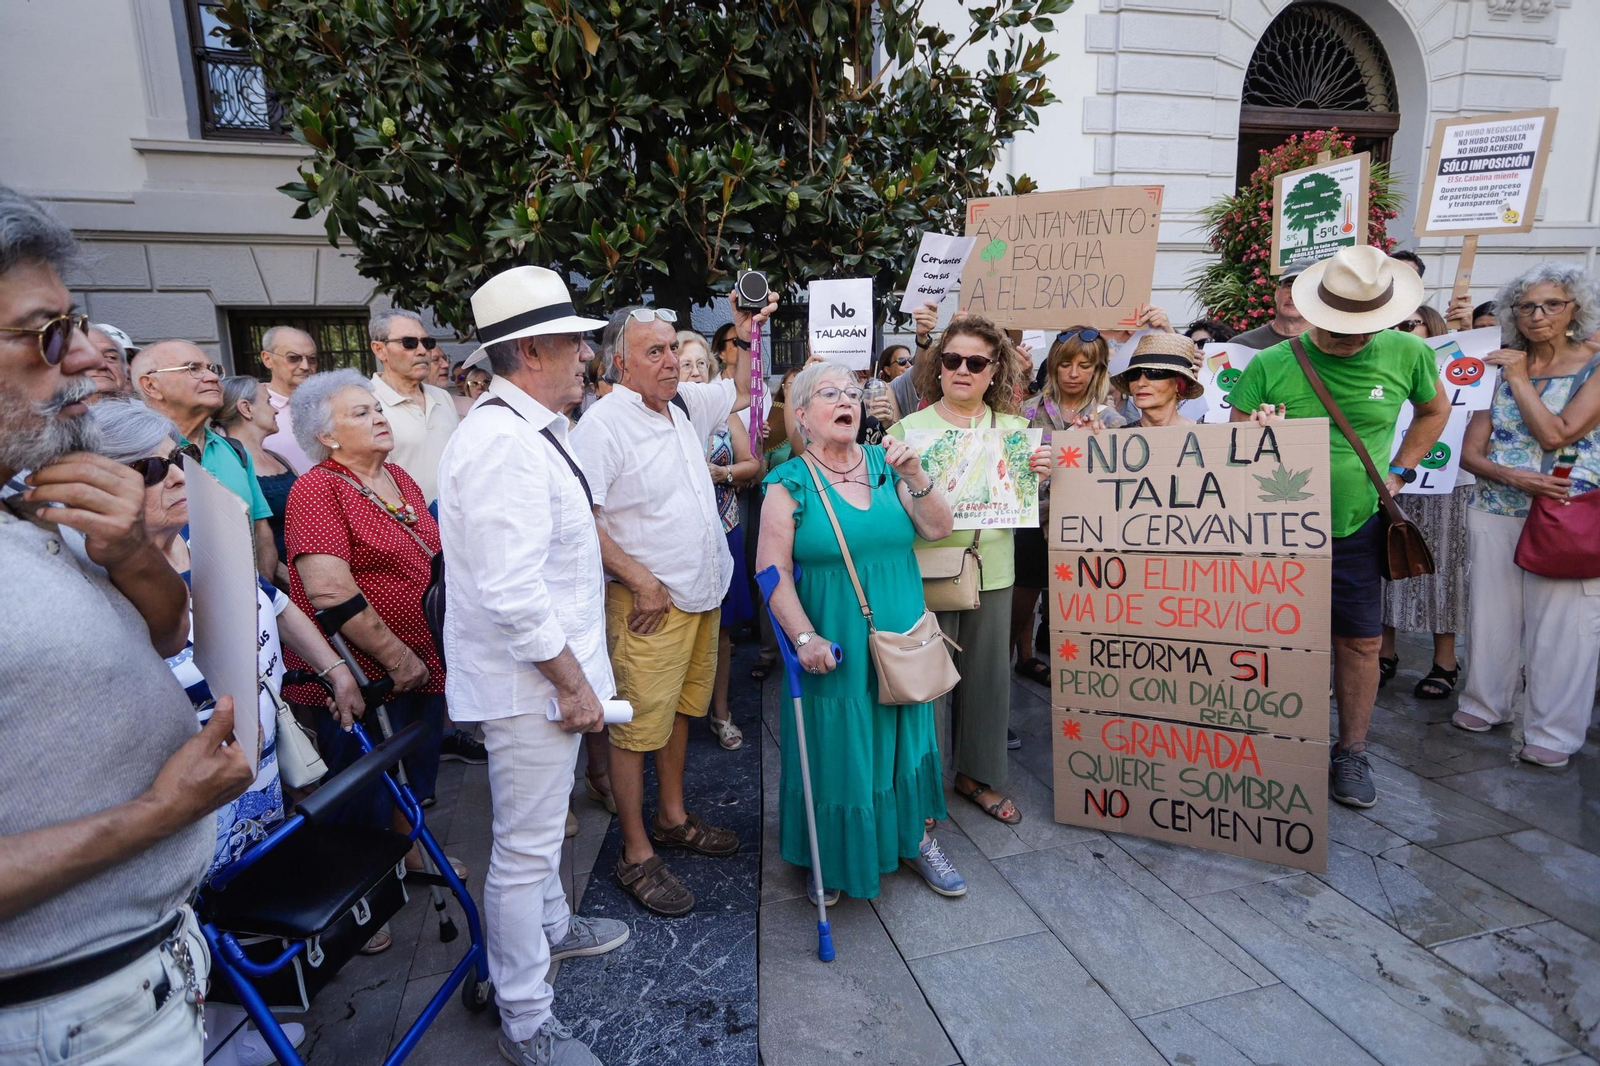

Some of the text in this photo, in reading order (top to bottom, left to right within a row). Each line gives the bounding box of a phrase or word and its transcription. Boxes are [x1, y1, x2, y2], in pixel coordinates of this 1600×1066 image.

[1454, 123, 1535, 138] NO HUBO NEGOCIACIÓN
[1469, 137, 1488, 145] HUBO
[1490, 133, 1526, 144] CONSULTA
[1469, 146, 1488, 154] HUBO
[1490, 143, 1523, 152] ACUERDO
[1442, 155, 1530, 173] SÓLO IMPOSICIÓN
[1464, 174, 1492, 182] Catalina
[1494, 172, 1518, 180] miente
[1441, 186, 1477, 194] Queremos
[1490, 183, 1521, 192] proceso
[1449, 190, 1499, 201] participación
[921, 253, 962, 264] Cervantes
[1012, 240, 1105, 271] ESCUCHA
[918, 285, 945, 294] árboles
[968, 274, 1125, 311] A EL BARRIO
[831, 302, 855, 319] No
[815, 325, 866, 339] TALARÁN
[1087, 426, 1281, 474] NO A LA
[1097, 472, 1225, 512] TALA
[1060, 511, 1327, 549] EN CERVANTES
[1077, 556, 1305, 596] NO ELIMINAR
[1058, 592, 1300, 635] VIA DE SERVICIO
[1090, 638, 1269, 688] REFORMA SI
[1059, 668, 1303, 719] PERO CON DIÁLOGO
[1200, 708, 1267, 731] REAL
[1101, 719, 1262, 776] GRANADA
[1068, 750, 1313, 815] QUIERE SOMBRA
[1084, 788, 1314, 854] NO CEMENTO
